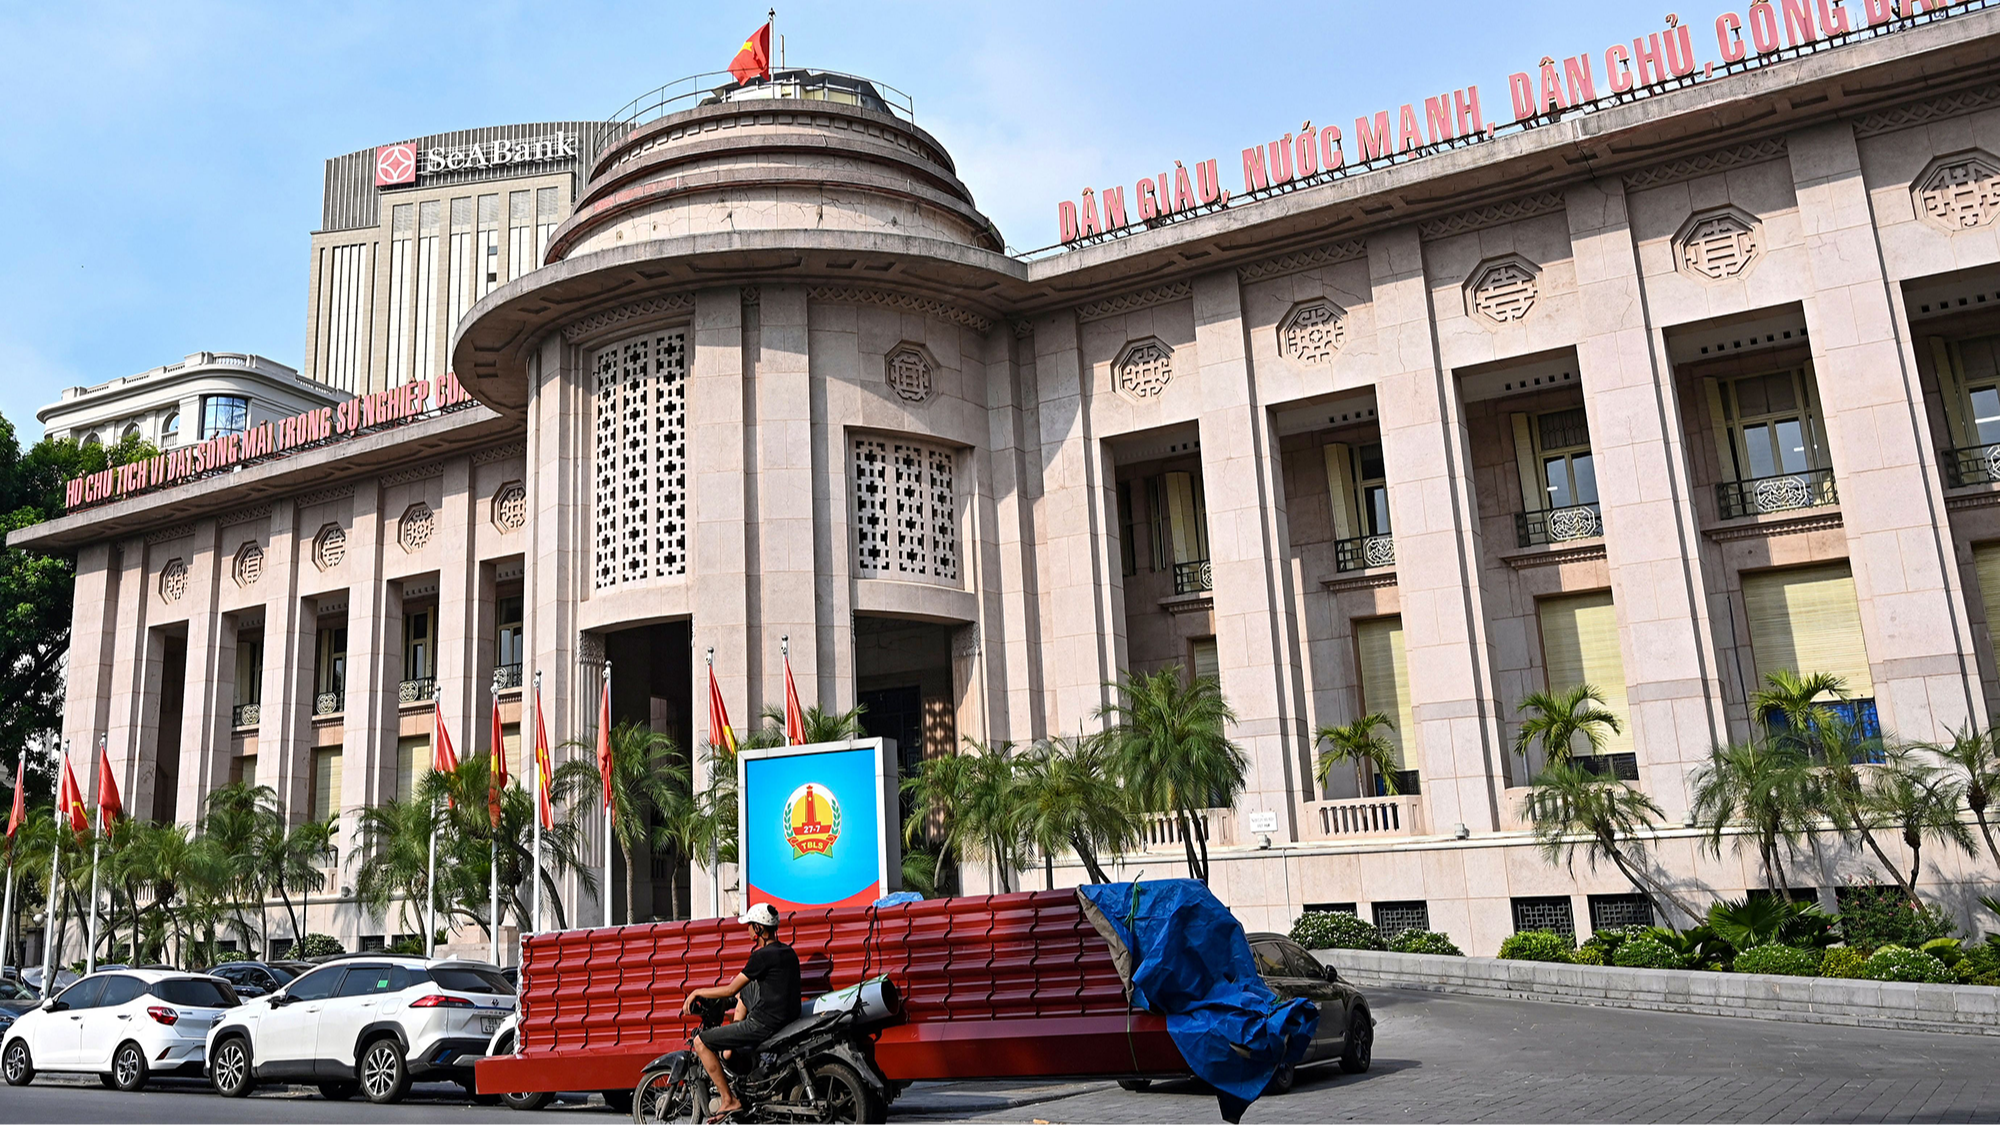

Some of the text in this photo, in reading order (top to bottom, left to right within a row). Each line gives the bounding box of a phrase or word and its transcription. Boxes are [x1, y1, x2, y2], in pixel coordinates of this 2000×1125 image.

[428, 131, 576, 172] SeABank
[1058, 186, 1126, 243] DÂN
[1136, 160, 1231, 220] GIÀU,
[1242, 120, 1343, 193] NƯỚC
[1355, 85, 1495, 162] MẠNH,
[1508, 56, 1597, 120] DÂN
[1715, 0, 1850, 63] CÔNG
[65, 469, 86, 509] HỒ
[85, 461, 114, 503] CHỦ
[116, 459, 148, 499] TỊCH
[196, 430, 240, 473] SỐNG
[278, 407, 332, 450] TRONG
[336, 394, 362, 436] SỰ
[363, 377, 430, 429] NGHIỆP
[801, 841, 824, 850] TBLS
